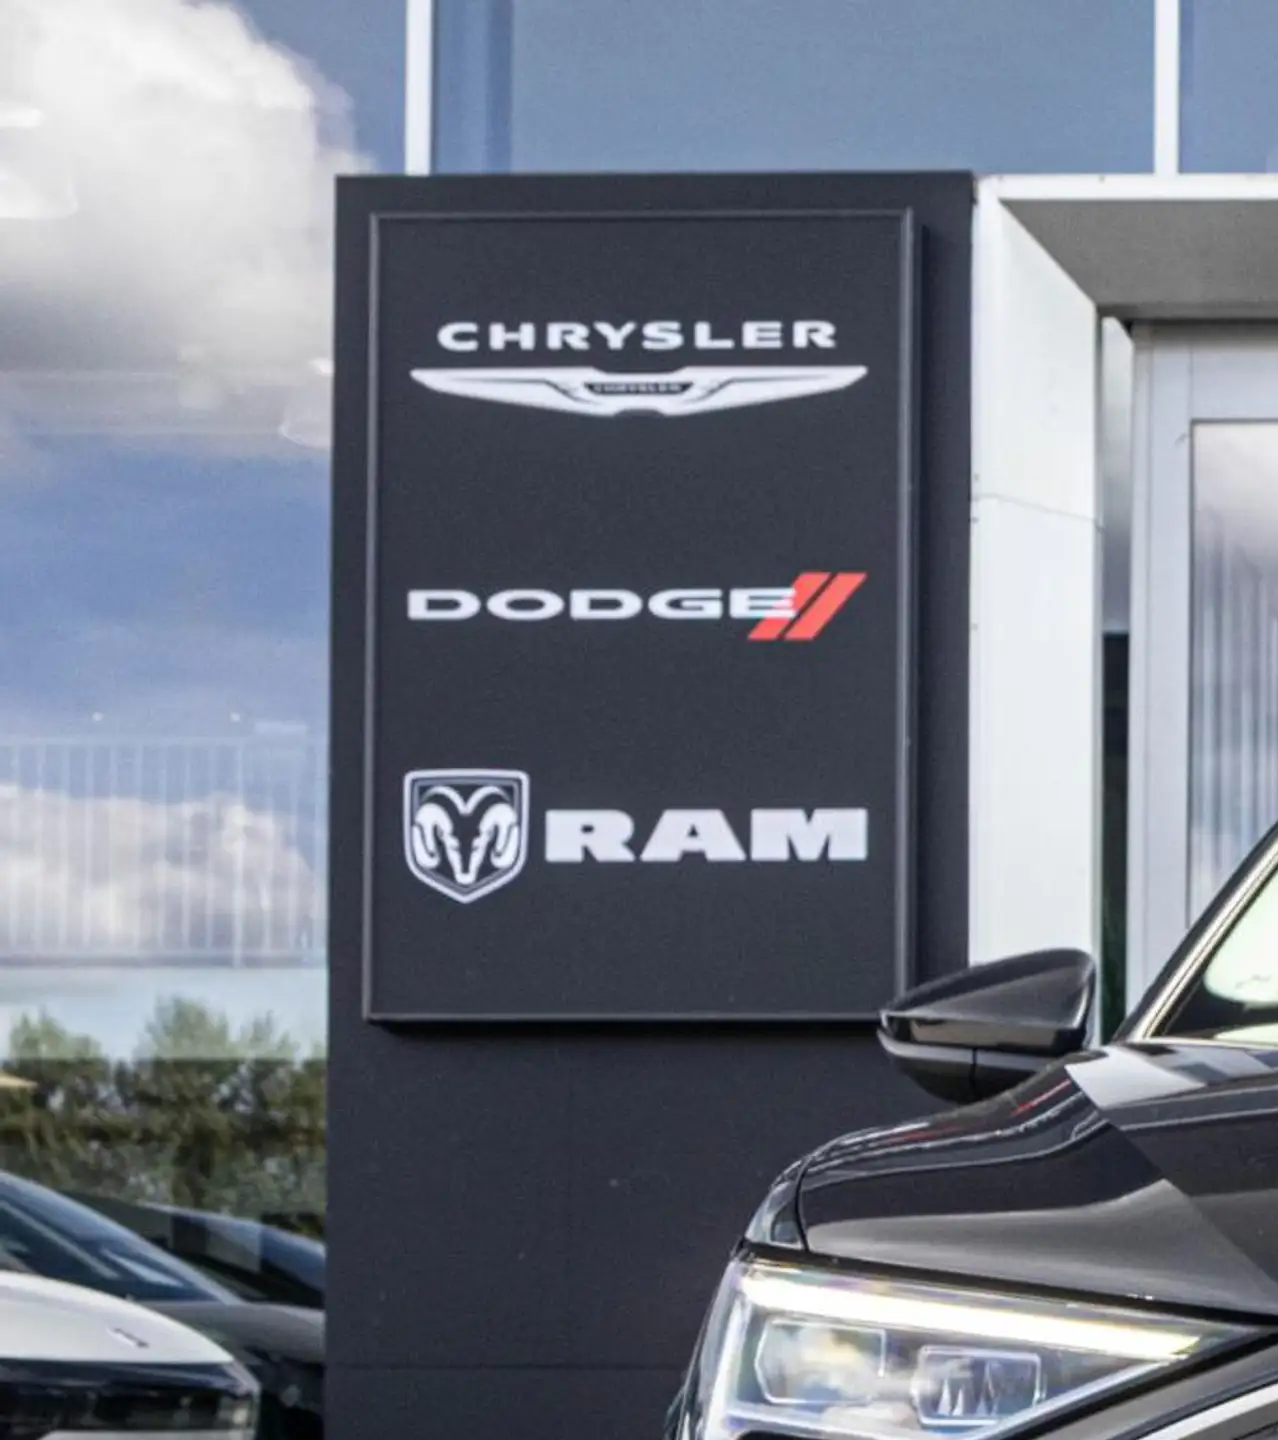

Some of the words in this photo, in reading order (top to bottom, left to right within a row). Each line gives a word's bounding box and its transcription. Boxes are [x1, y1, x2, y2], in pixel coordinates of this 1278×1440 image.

[437, 320, 837, 351] CHRYSLER
[408, 587, 797, 620] DODGE
[545, 808, 868, 862] RAM
